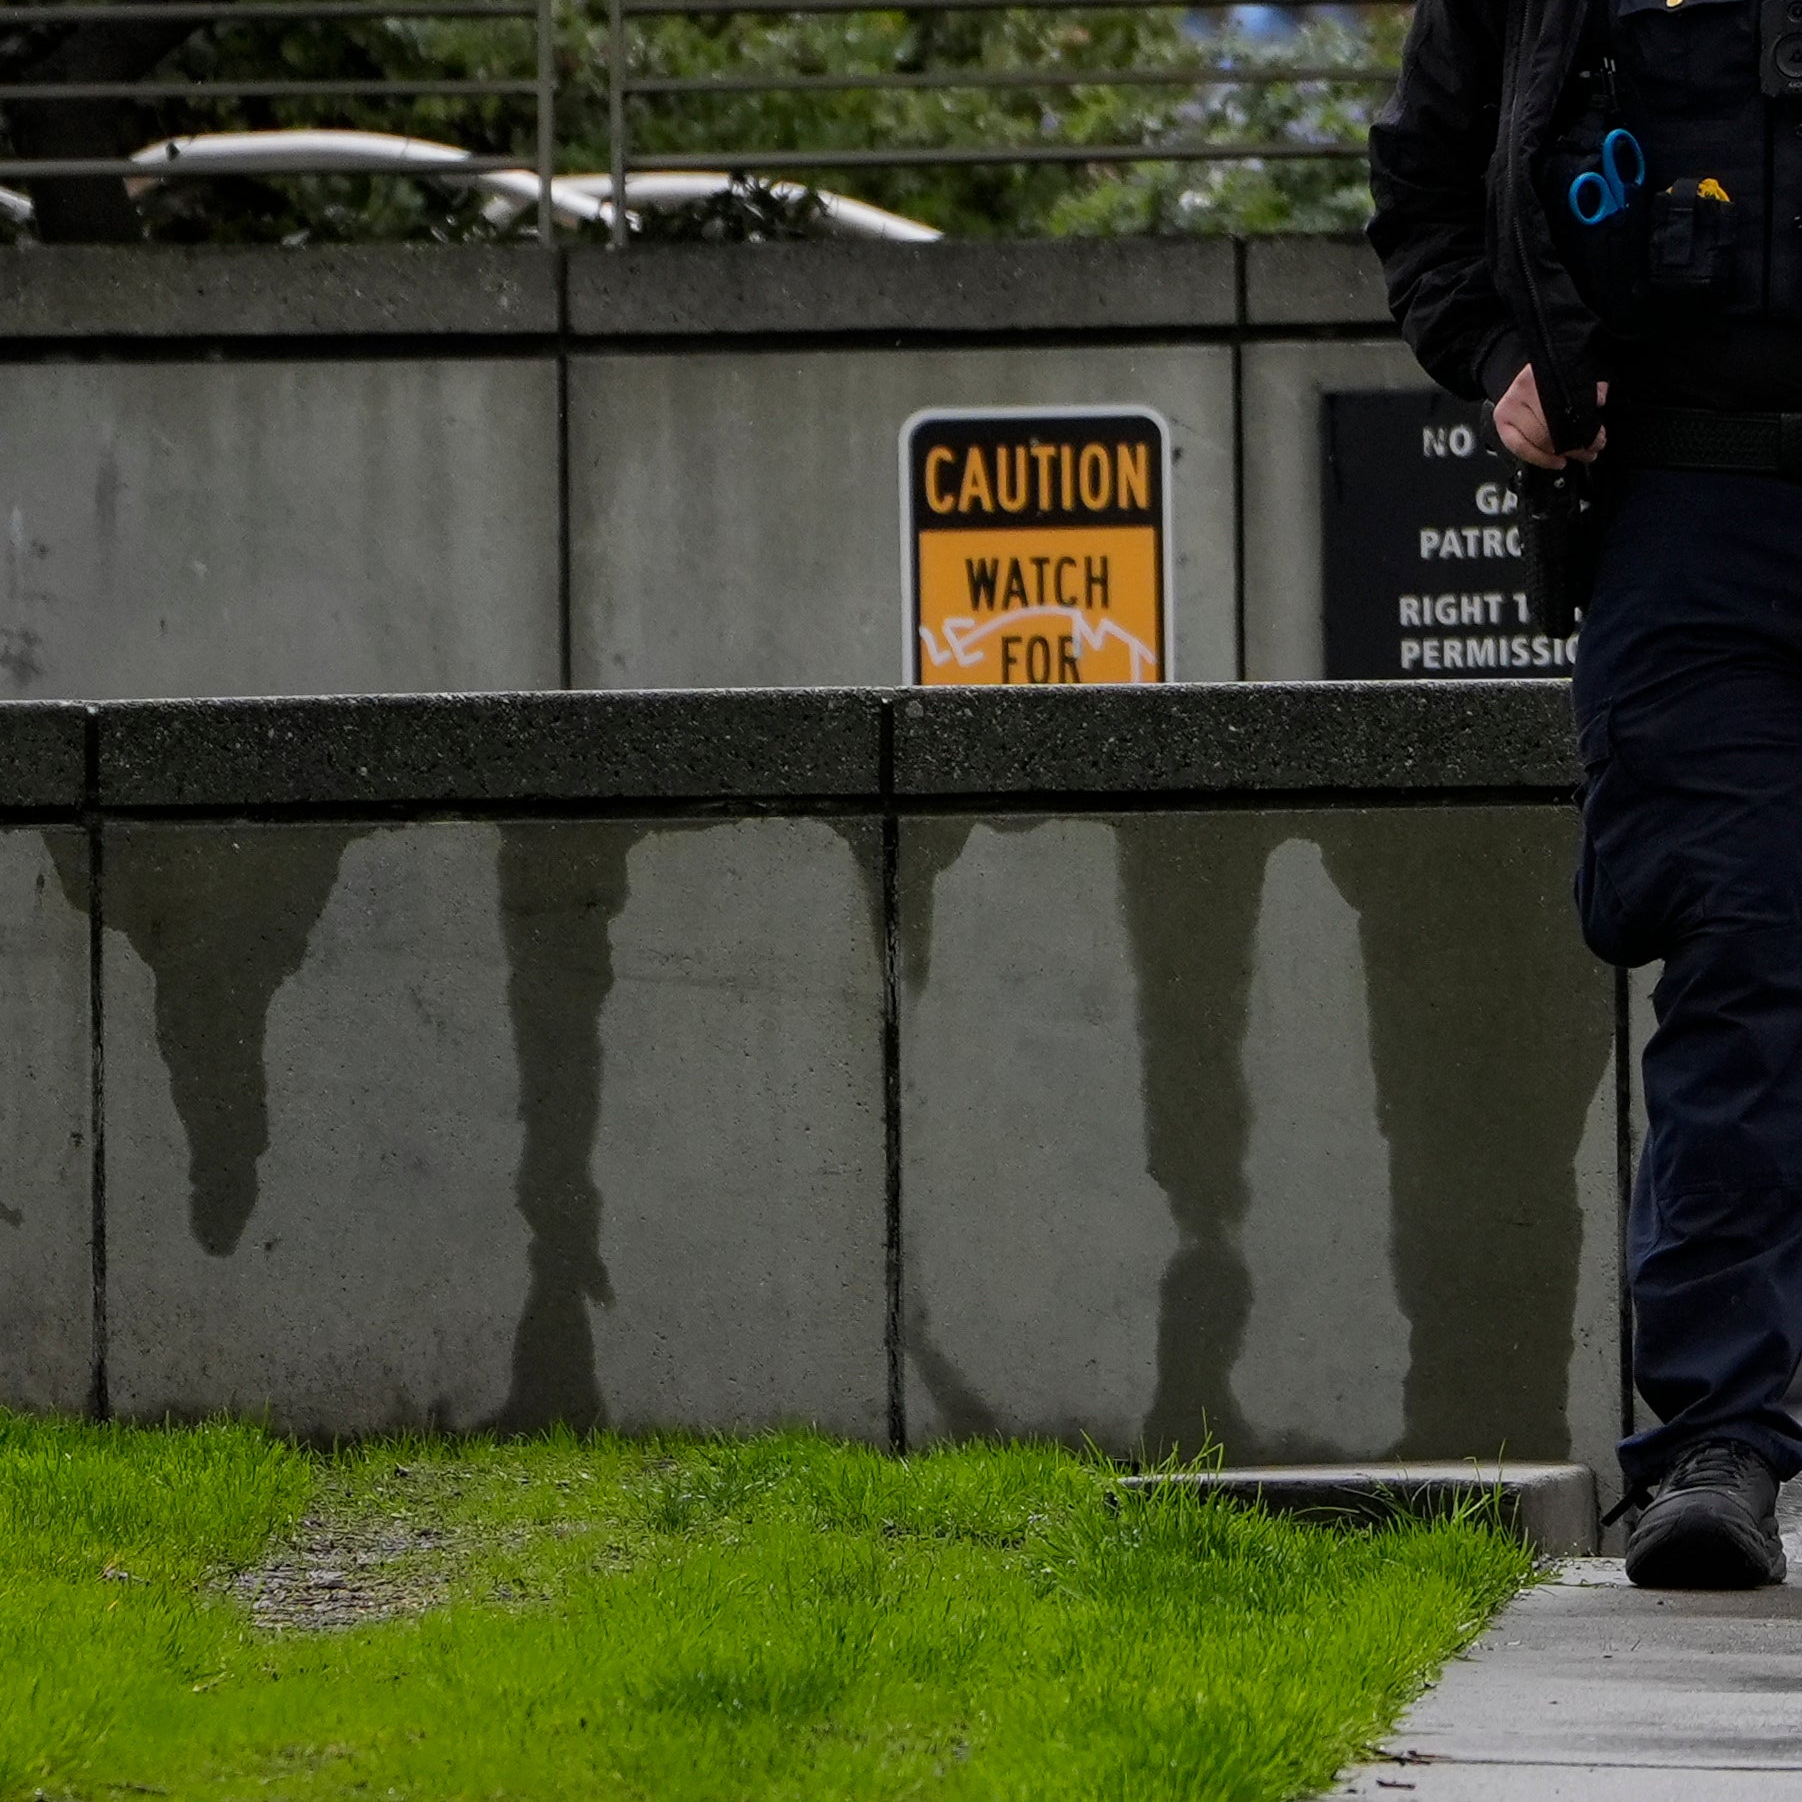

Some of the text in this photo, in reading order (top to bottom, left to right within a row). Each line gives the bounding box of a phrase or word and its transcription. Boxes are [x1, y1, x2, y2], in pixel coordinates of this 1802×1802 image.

[1422, 424, 1472, 458] NO
[924, 442, 1151, 514] CAUTION
[1419, 526, 1524, 560] PATRO
[965, 555, 1109, 612] WATCH
[1399, 593, 1502, 627] RIGHT
[1001, 635, 1082, 684] FOR
[1401, 635, 1579, 669] PERMISSI
